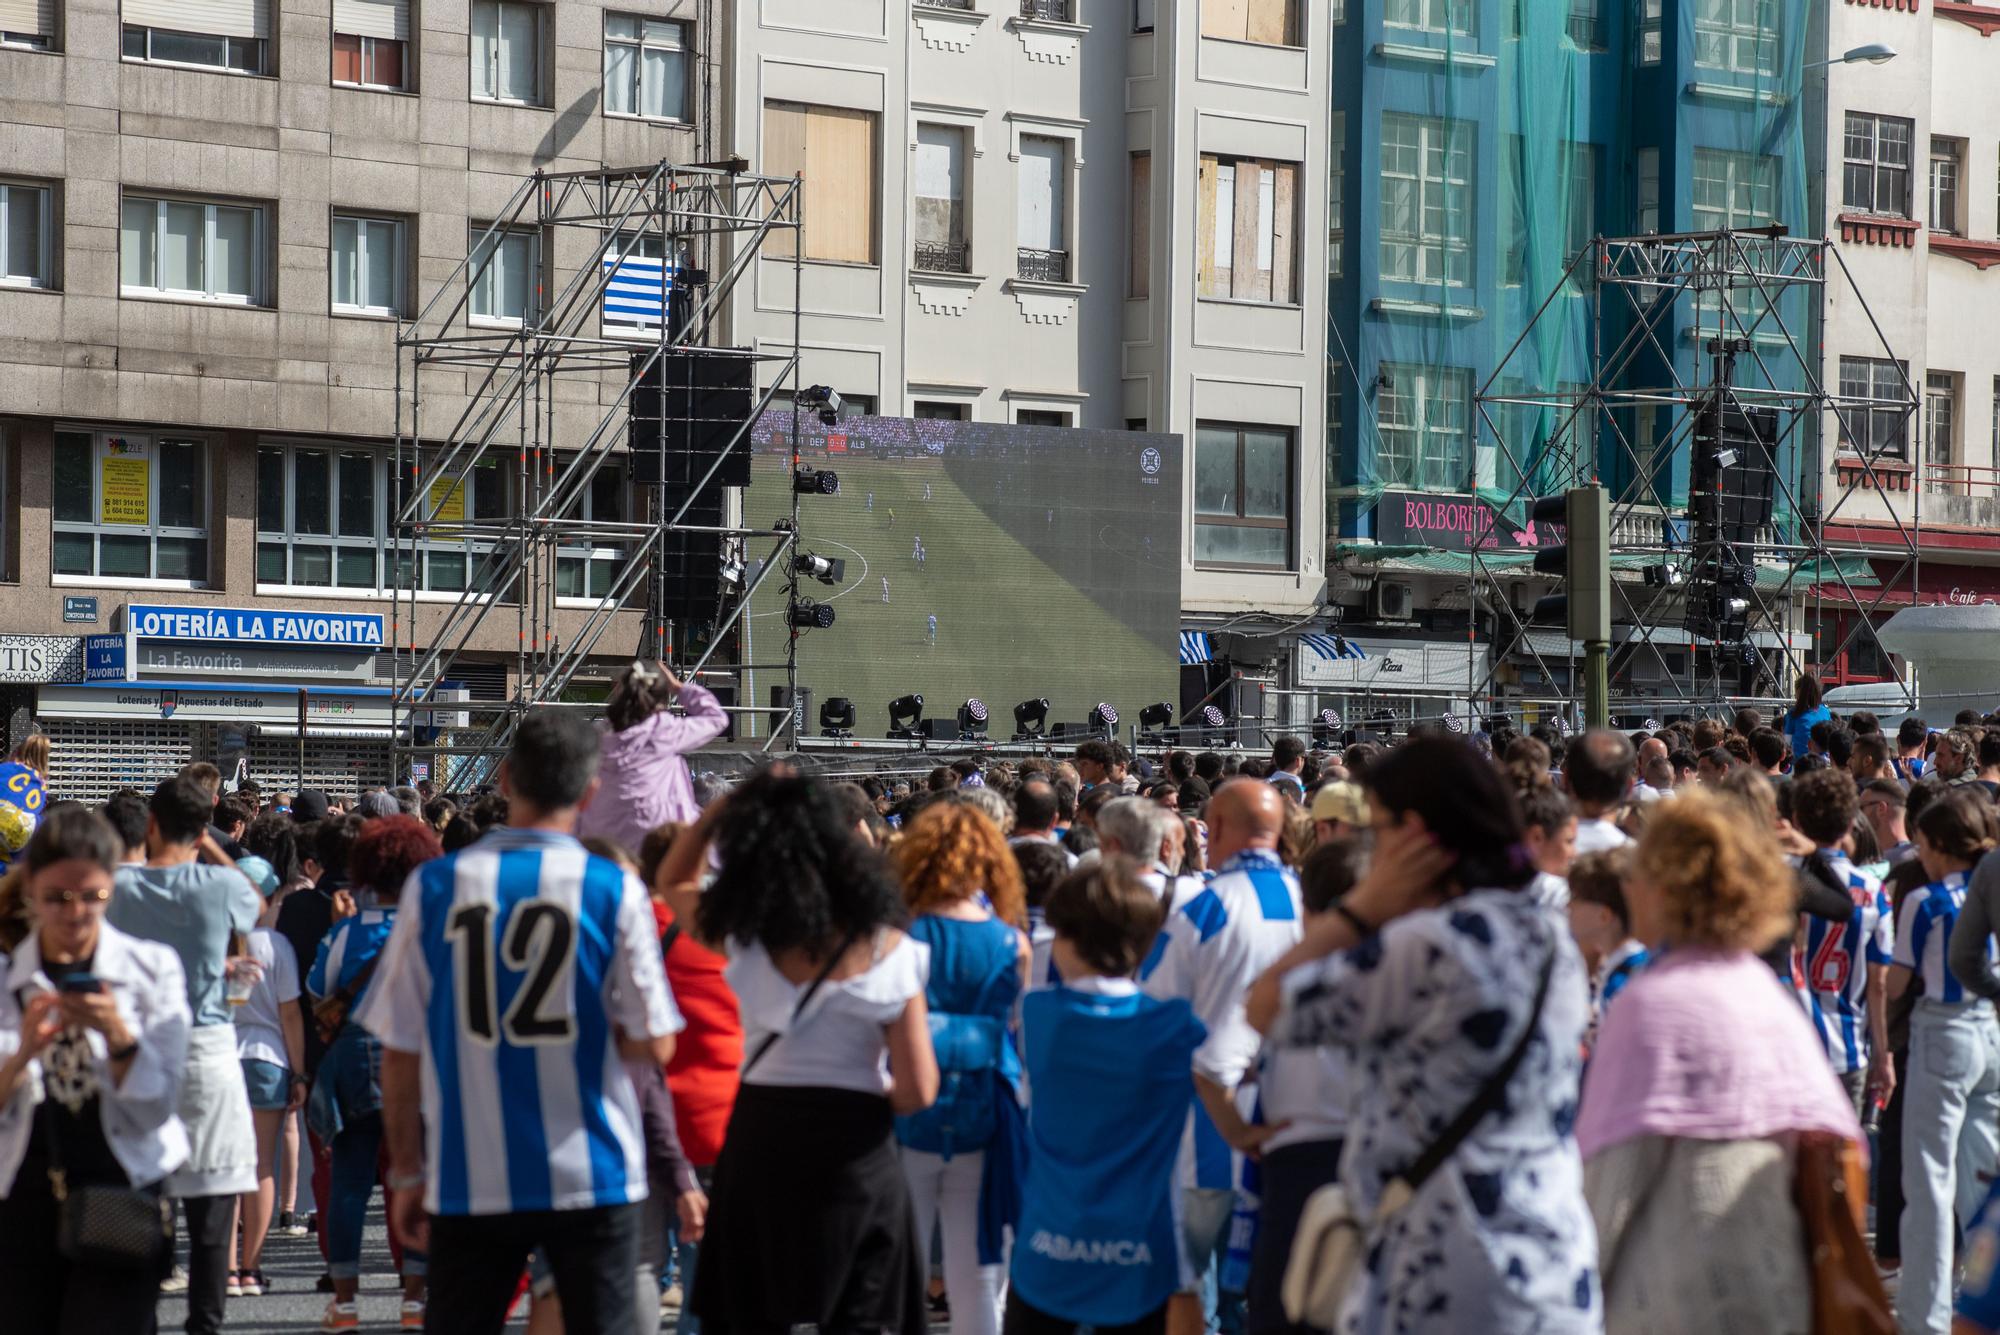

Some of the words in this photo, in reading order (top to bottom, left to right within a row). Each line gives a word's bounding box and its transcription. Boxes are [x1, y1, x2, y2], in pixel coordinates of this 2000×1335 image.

[809, 437, 825, 447] DEP
[850, 440, 866, 449] ALB
[1950, 587, 1977, 605] Café
[130, 610, 230, 638] LOTERÍA
[237, 615, 266, 640] LA
[273, 617, 381, 643] FAVORITA
[89, 637, 124, 649] LOTERÍA
[0, 647, 42, 672] TIS
[101, 654, 112, 664] LA
[149, 650, 168, 668] La
[173, 651, 243, 672] Favorita
[256, 661, 319, 674] Administración
[334, 664, 340, 674] 5
[87, 667, 126, 678] FAVORITA
[116, 694, 153, 705] Loterías
[154, 696, 160, 708] y
[178, 696, 218, 708] Apuestas
[219, 696, 233, 707] del
[234, 697, 264, 709] Estado
[795, 695, 804, 730] KACHET
[445, 901, 578, 1043] 12
[1030, 1229, 1152, 1266] ABANCA
